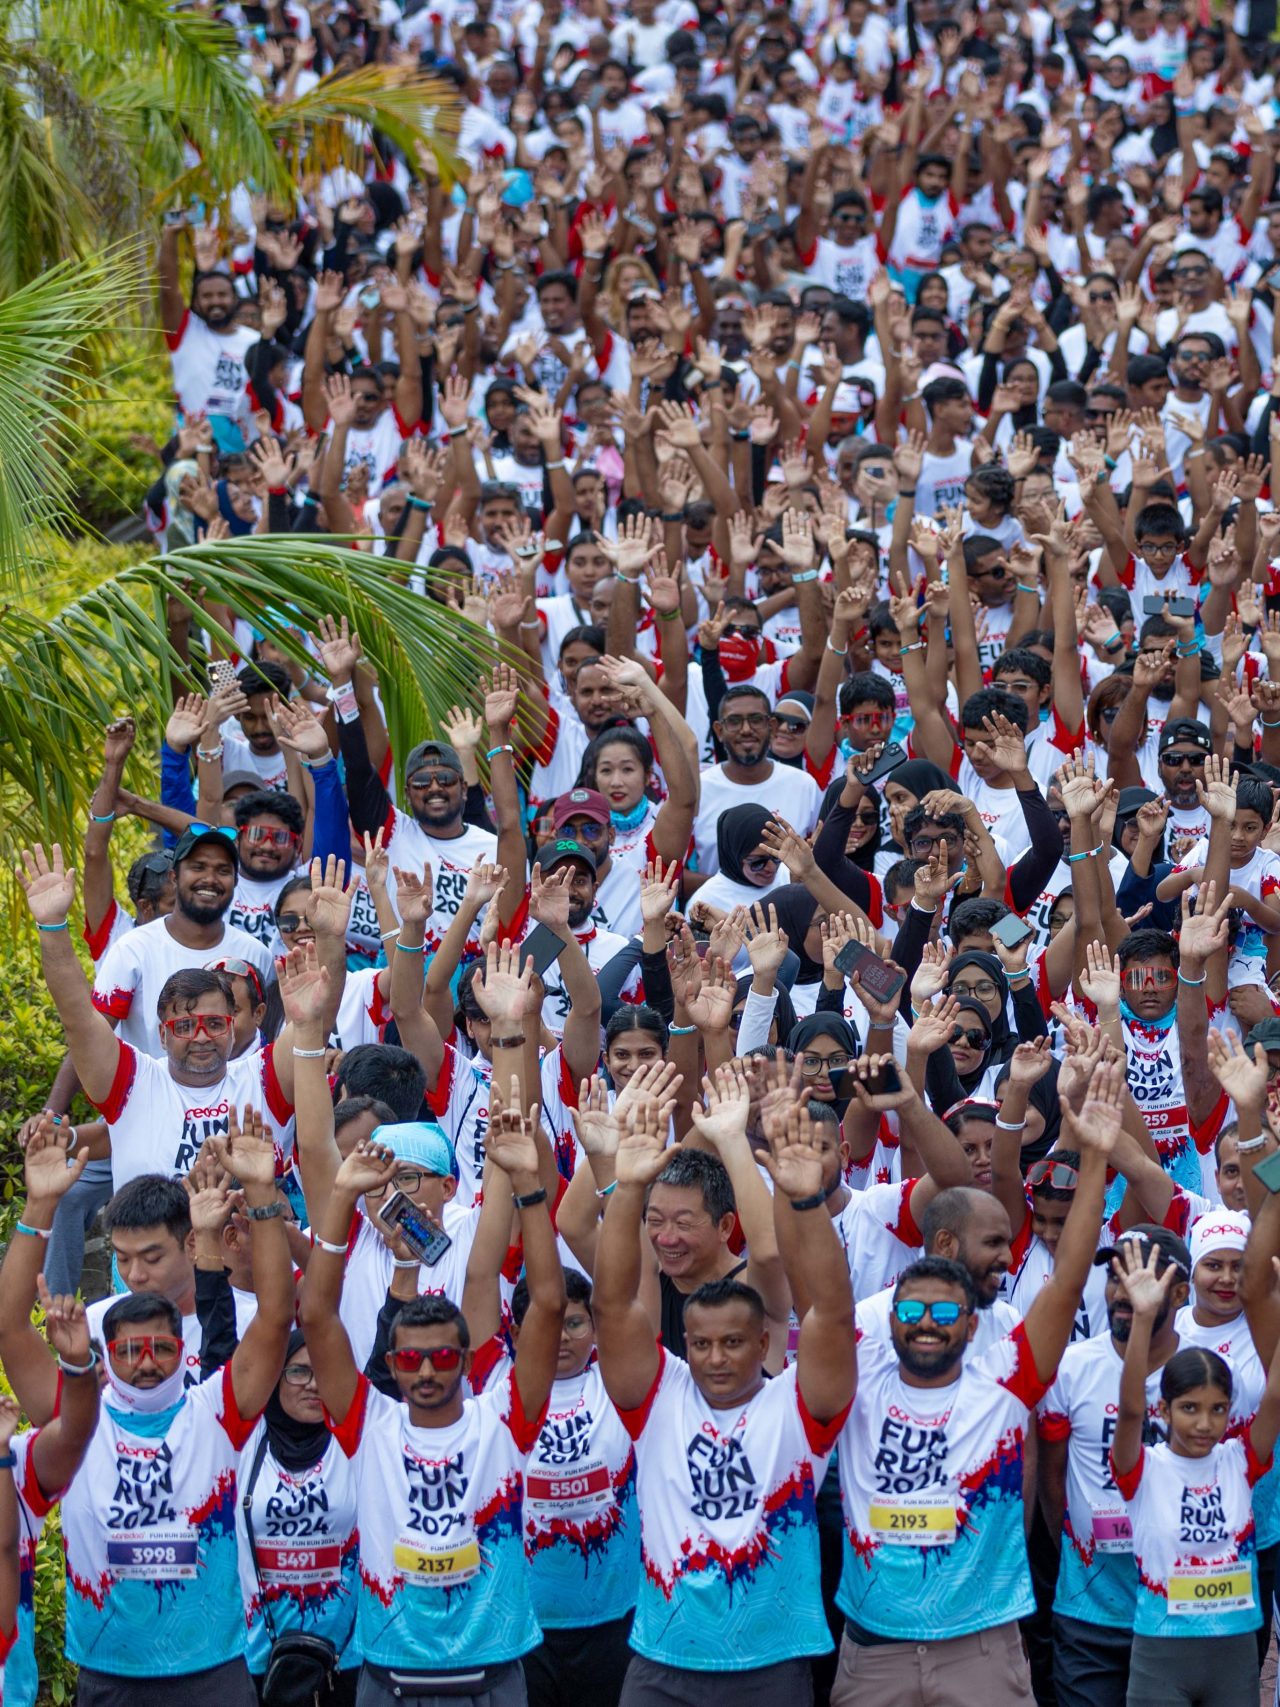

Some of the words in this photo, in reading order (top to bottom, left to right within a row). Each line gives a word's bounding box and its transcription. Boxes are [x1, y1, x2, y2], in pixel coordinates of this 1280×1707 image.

[356, 891, 377, 909] FU
[353, 907, 378, 924] RU
[352, 921, 381, 939] 202
[880, 1416, 947, 1454] FUN
[403, 1452, 463, 1485] FUN
[688, 1456, 756, 1497] RUN
[113, 1467, 173, 1505] RUN
[550, 1478, 589, 1497] 5501
[876, 1466, 948, 1495] 2024
[266, 1488, 328, 1519] RUN
[108, 1500, 176, 1529] 2024
[890, 1514, 927, 1529] 2193
[1181, 1506, 1226, 1526] RUN
[266, 1517, 328, 1537] 2024
[1180, 1527, 1229, 1543] 2024
[132, 1547, 176, 1563] 3998
[277, 1552, 316, 1567] 5491
[418, 1558, 454, 1572] 2137
[1194, 1582, 1233, 1597] 0091
